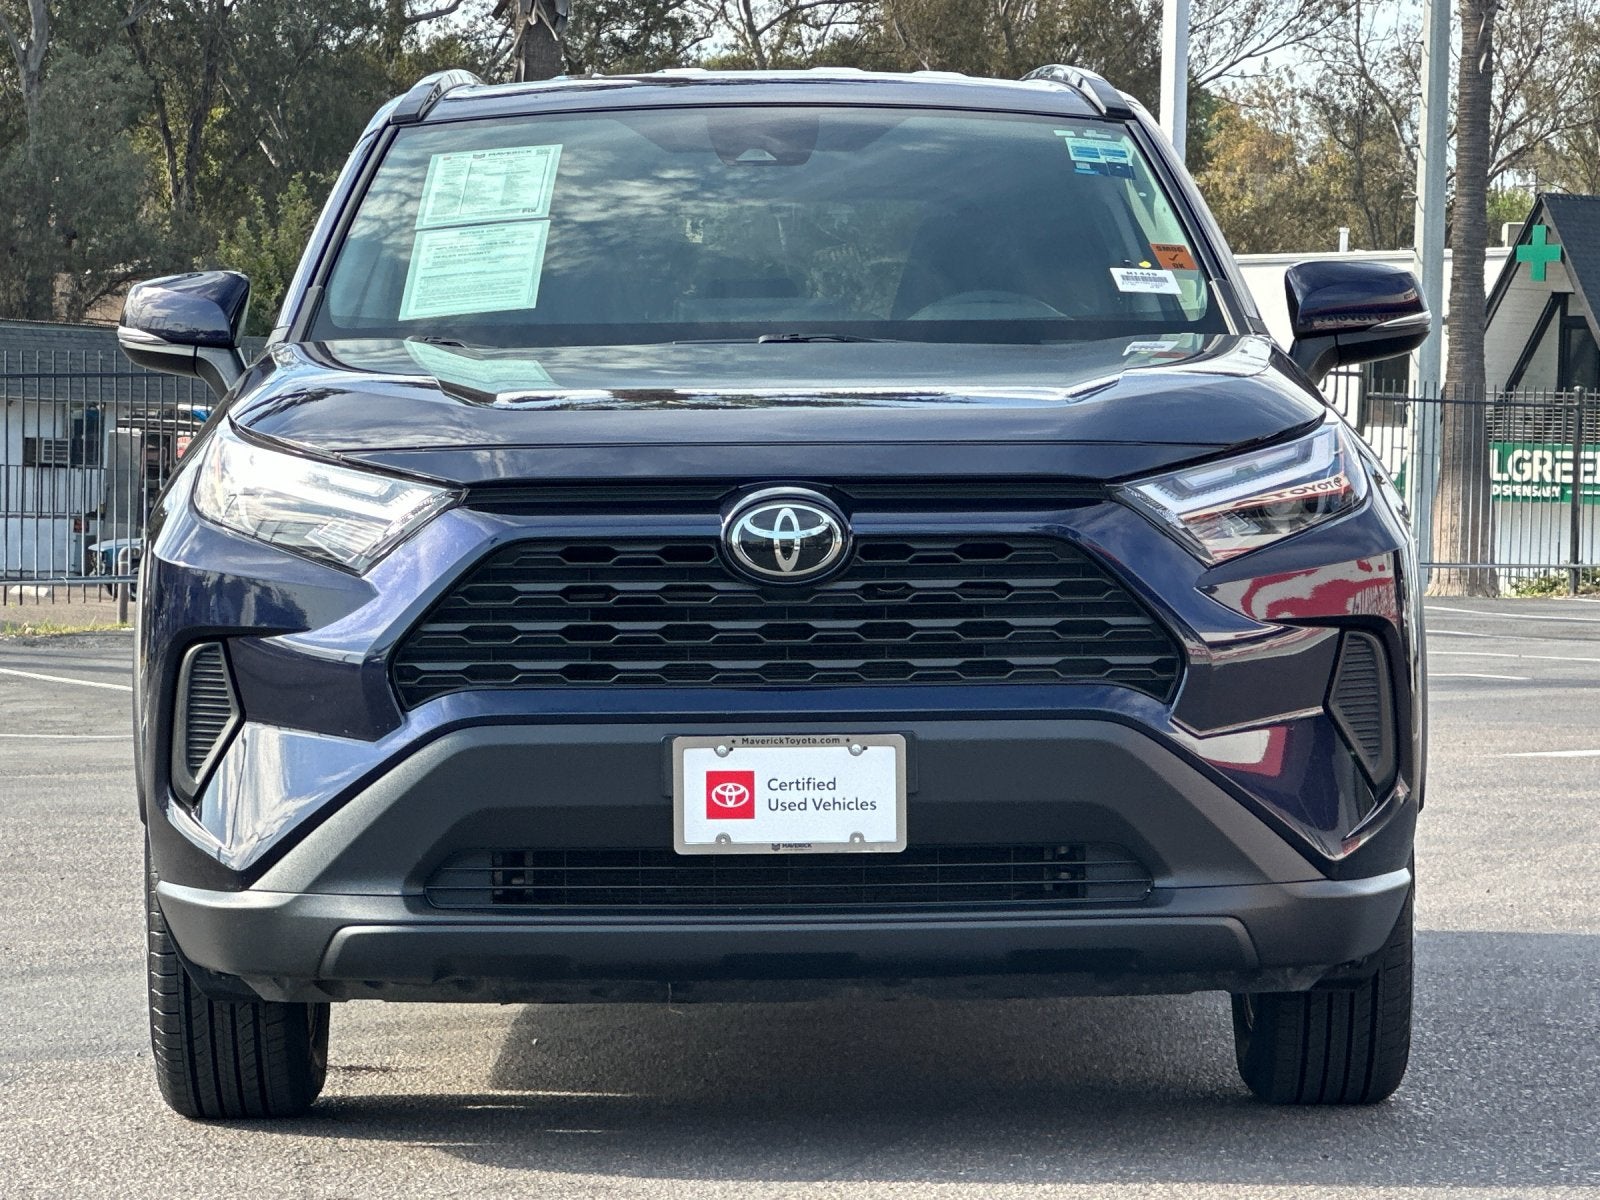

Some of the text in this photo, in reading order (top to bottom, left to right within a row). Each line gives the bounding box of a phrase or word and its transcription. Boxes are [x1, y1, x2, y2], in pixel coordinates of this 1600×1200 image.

[1492, 484, 1560, 497] DSPENSARY
[741, 737, 840, 745] MaverickToyota.com
[767, 777, 836, 791] Certified
[767, 797, 877, 811] Used Vehicles
